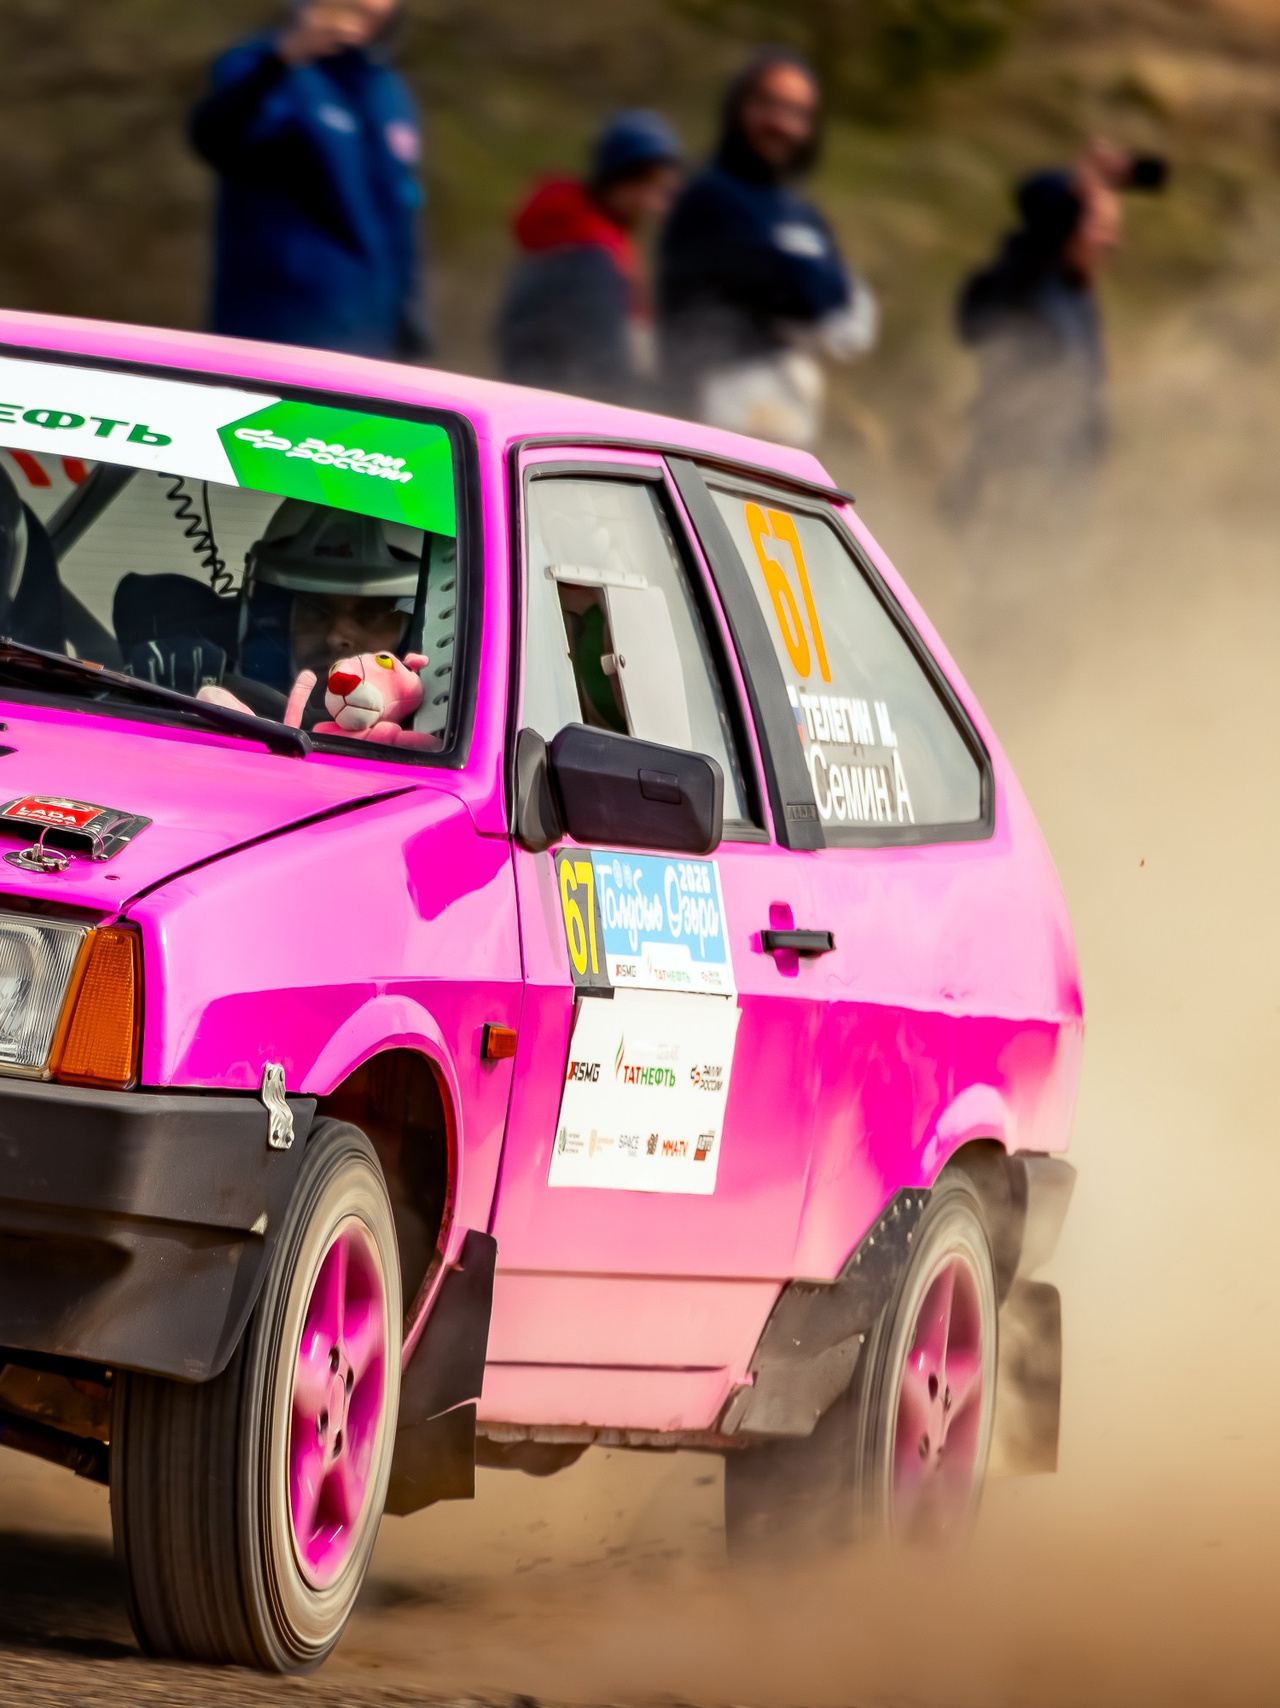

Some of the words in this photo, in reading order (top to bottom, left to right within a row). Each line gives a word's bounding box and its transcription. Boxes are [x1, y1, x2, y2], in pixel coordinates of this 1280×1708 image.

[285, 446, 413, 484] РОССИИ
[745, 501, 832, 683] 67
[17, 806, 77, 823] LADA
[560, 858, 599, 975] 67
[624, 1065, 676, 1088] ТАТНЕФТЬ
